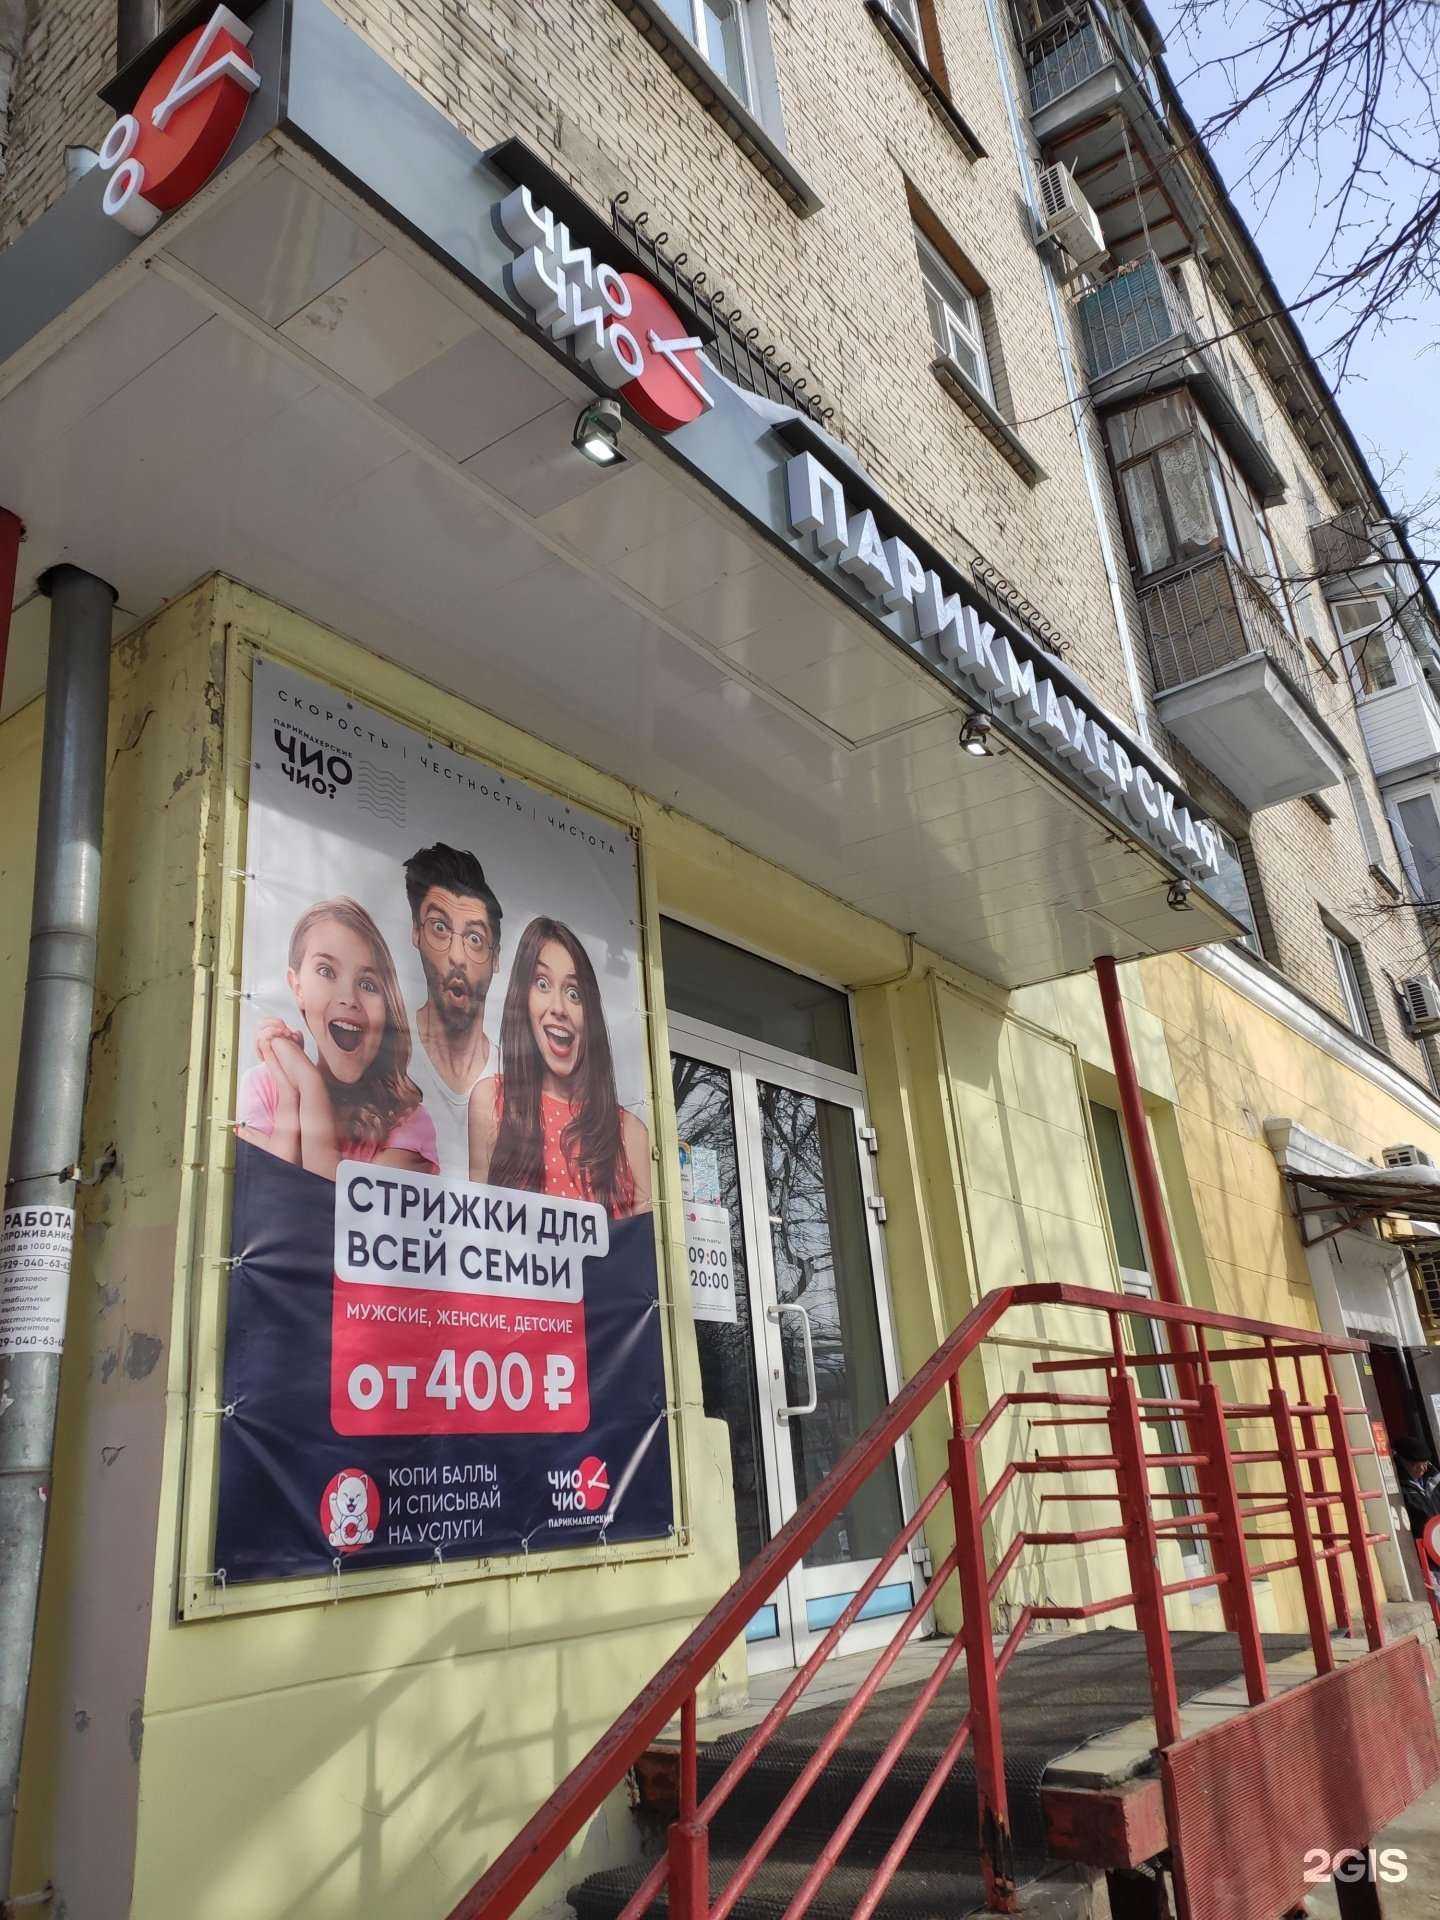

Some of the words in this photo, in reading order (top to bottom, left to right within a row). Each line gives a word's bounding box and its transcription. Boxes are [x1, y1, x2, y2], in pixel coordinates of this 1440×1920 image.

[518, 184, 633, 318] ЧИО
[528, 245, 645, 377] ЧИО
[787, 450, 1220, 879] ПАРИКМАХЕРСКАЯ
[274, 728, 353, 785] ЧИО
[278, 690, 389, 749] СКОРОСТЬ
[420, 756, 523, 811] ЧЕСТНОСТЬ
[547, 815, 616, 855] ЧИСТОТА
[281, 763, 337, 800] ЧИО?
[4, 1211, 71, 1230] РАБОТА
[347, 1176, 527, 1235] СТРИЖКИ
[537, 1207, 598, 1246] ДЛЯ
[347, 1228, 447, 1276] ВСЕЙ
[459, 1245, 571, 1289] СЕМЬИ
[688, 1246, 727, 1268] 09:00
[690, 1270, 729, 1290] 20:00
[346, 1303, 432, 1328] МУЖСКИЕ,
[437, 1309, 511, 1333] ЖЕНСКИЕ,
[514, 1315, 574, 1334] ДЕТСКИЕ
[425, 1349, 533, 1412] 400
[388, 1467, 438, 1487] КОПИ
[442, 1464, 497, 1485] БАЛЛЫ
[547, 1470, 583, 1490] ЧИО
[388, 1497, 401, 1516] И
[406, 1485, 501, 1514] СПИСЫВАЙ
[551, 1491, 587, 1511] ЧИО
[388, 1525, 413, 1545] НА
[417, 1519, 483, 1543] УСЛУГИ
[548, 1514, 615, 1529] ПАРИКМАХЕРСКИЕ
